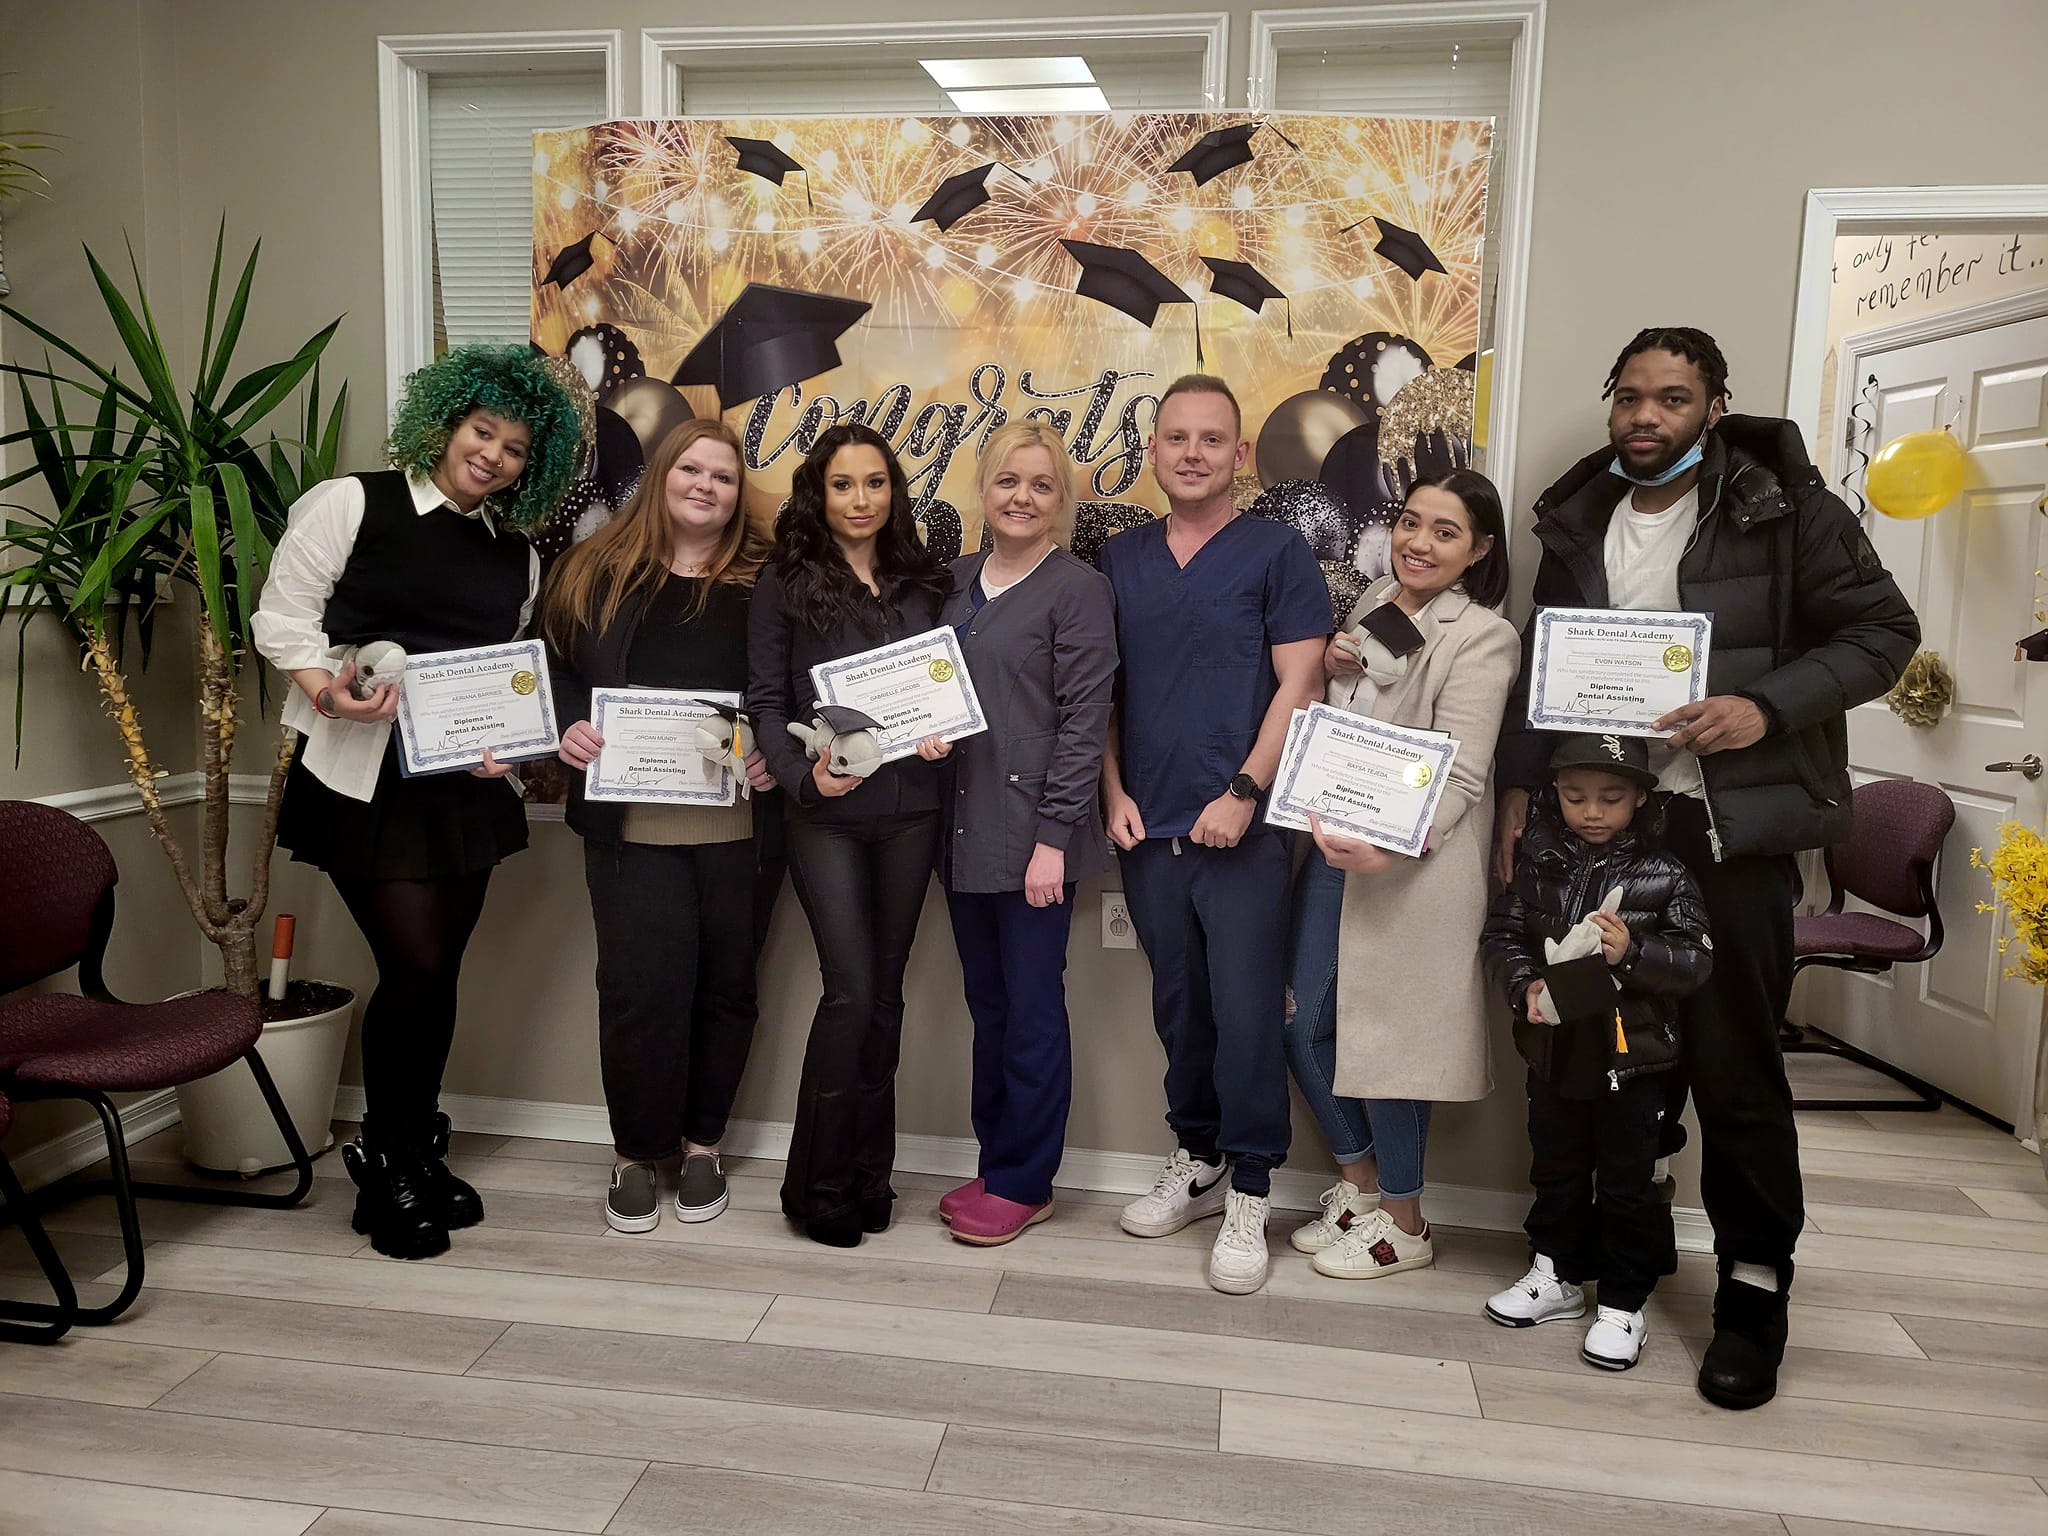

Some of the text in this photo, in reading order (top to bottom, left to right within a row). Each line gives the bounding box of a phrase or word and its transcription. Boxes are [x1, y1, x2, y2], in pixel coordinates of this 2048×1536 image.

[1853, 234, 1893, 273] only
[1857, 251, 1983, 318] remember
[1567, 627, 1594, 636] Shark
[1597, 628, 1628, 638] Dental
[1630, 630, 1674, 642] Academy
[845, 671, 869, 682] Shark
[870, 662, 896, 676] Dental
[897, 652, 932, 667] Academy
[1614, 659, 1642, 667] WATSON
[419, 670, 445, 681] Shark
[446, 665, 475, 677] Dental
[477, 661, 514, 672] Academy
[1590, 683, 1624, 691] Diploma
[1577, 692, 1645, 703] Dental Assisting
[619, 707, 642, 716] Shark
[644, 708, 670, 717] Dental
[883, 709, 911, 722] Diploma
[900, 711, 932, 726] Assisting
[454, 715, 484, 726] Diploma
[445, 721, 505, 736] Dental Assisting
[1330, 727, 1356, 741] Shark
[1356, 735, 1385, 750] Dental
[1386, 743, 1424, 760] Academy
[639, 757, 668, 765] Diploma
[653, 766, 686, 774] Assisting
[1336, 783, 1366, 798] Diploma
[1367, 792, 1374, 801] in
[1322, 789, 1346, 802] Dental
[1347, 797, 1381, 814] Assisting
